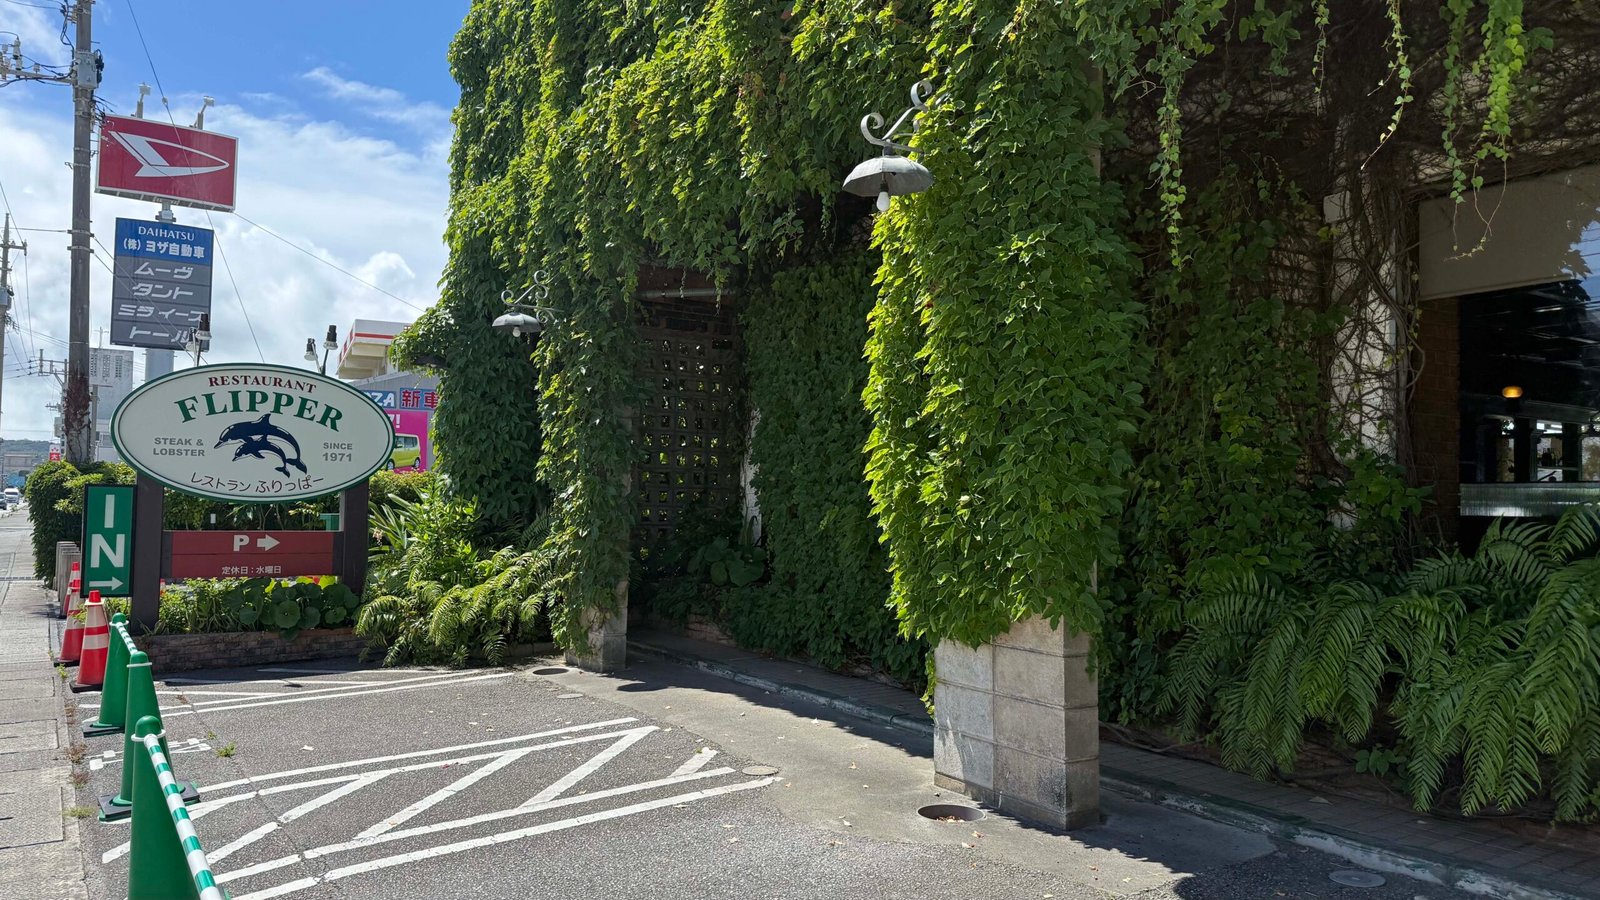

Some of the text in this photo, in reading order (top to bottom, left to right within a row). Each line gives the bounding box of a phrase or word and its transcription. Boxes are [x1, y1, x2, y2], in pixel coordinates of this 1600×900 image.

[138, 226, 195, 241] DAIHATSU
[134, 262, 194, 279] ムーヴ
[132, 283, 194, 300] タント
[129, 326, 191, 343] トール
[208, 375, 317, 394] RESTAURANT
[174, 390, 343, 433] FLIPPER
[154, 437, 204, 446] STEAK &
[323, 442, 353, 450] SINCE
[153, 448, 205, 457] LOBSTER
[322, 452, 353, 462] 1971
[90, 494, 125, 568] IN
[233, 534, 250, 552] P
